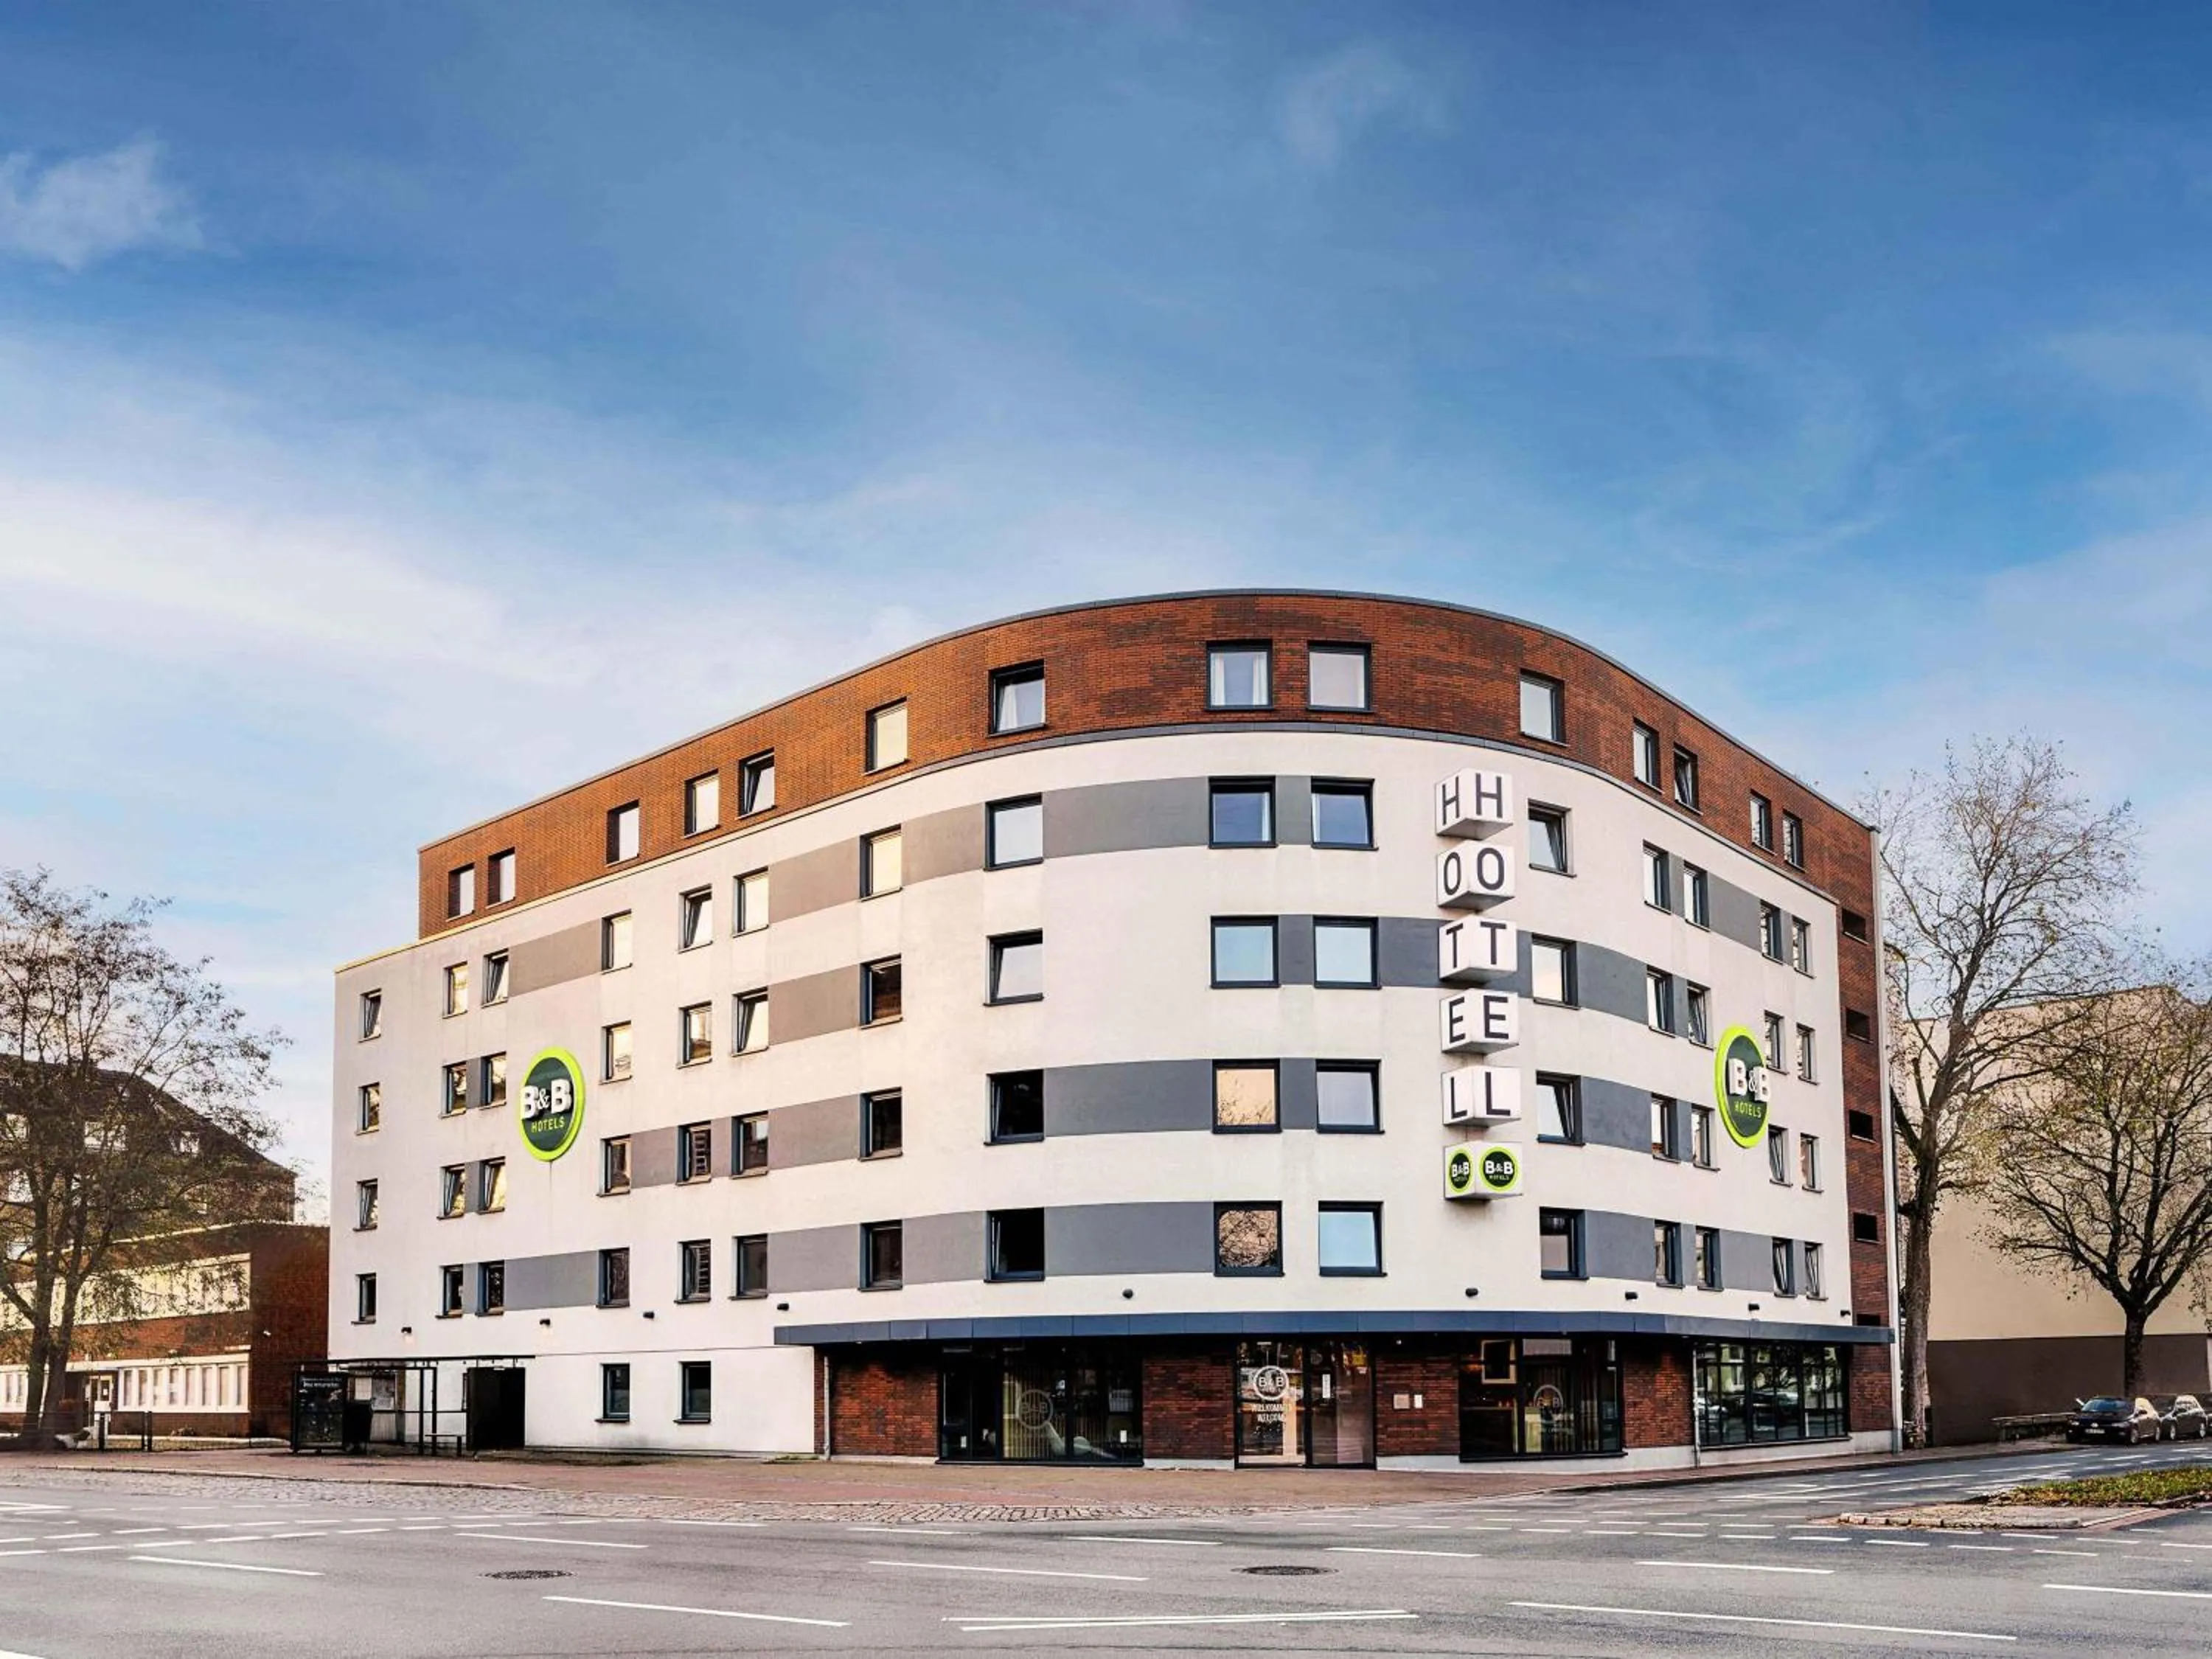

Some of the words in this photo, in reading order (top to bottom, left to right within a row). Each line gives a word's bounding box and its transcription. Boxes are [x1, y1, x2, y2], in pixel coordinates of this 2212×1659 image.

[1442, 776, 1467, 1119] HOTEL
[1475, 773, 1511, 1116] HOTEL
[1728, 1058, 1771, 1102] B&B
[520, 1078, 572, 1119] B&B
[1733, 1099, 1762, 1119] HOTELS
[531, 1116, 566, 1133] HOTELS
[1452, 1162, 1470, 1178] B&B
[1485, 1161, 1514, 1175] B&B
